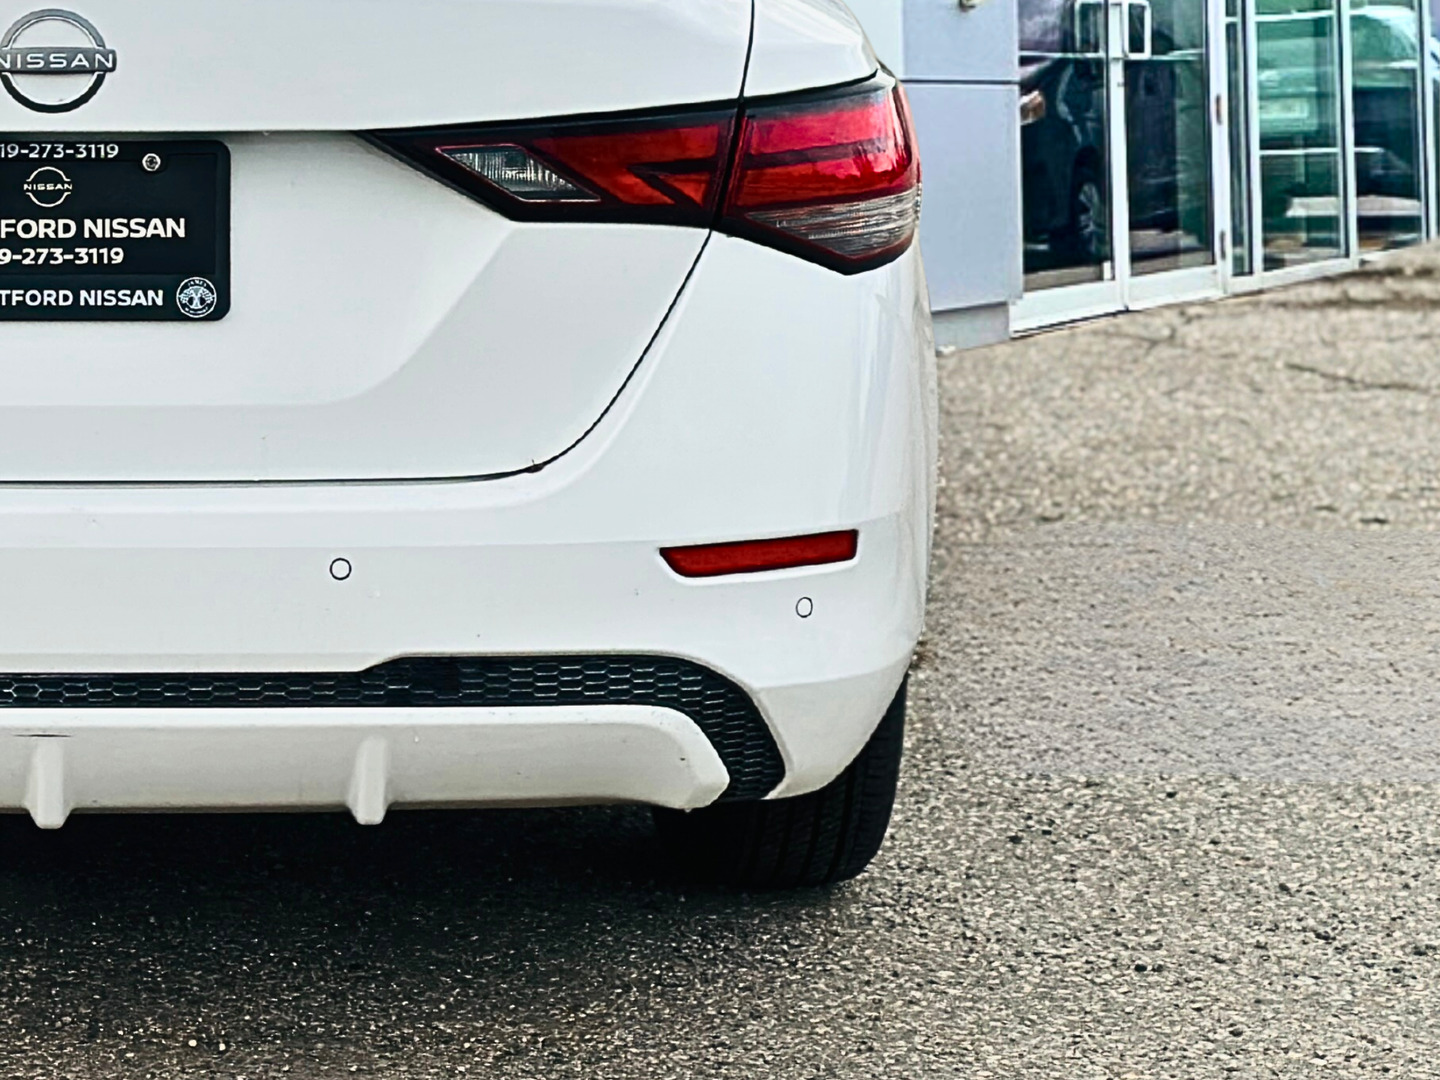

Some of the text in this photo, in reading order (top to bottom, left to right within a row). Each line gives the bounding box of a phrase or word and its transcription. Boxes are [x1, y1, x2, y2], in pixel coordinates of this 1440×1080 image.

[23, 183, 73, 191] NISSAN
[83, 217, 186, 238] NISSAN
[79, 289, 164, 306] NISSAN
